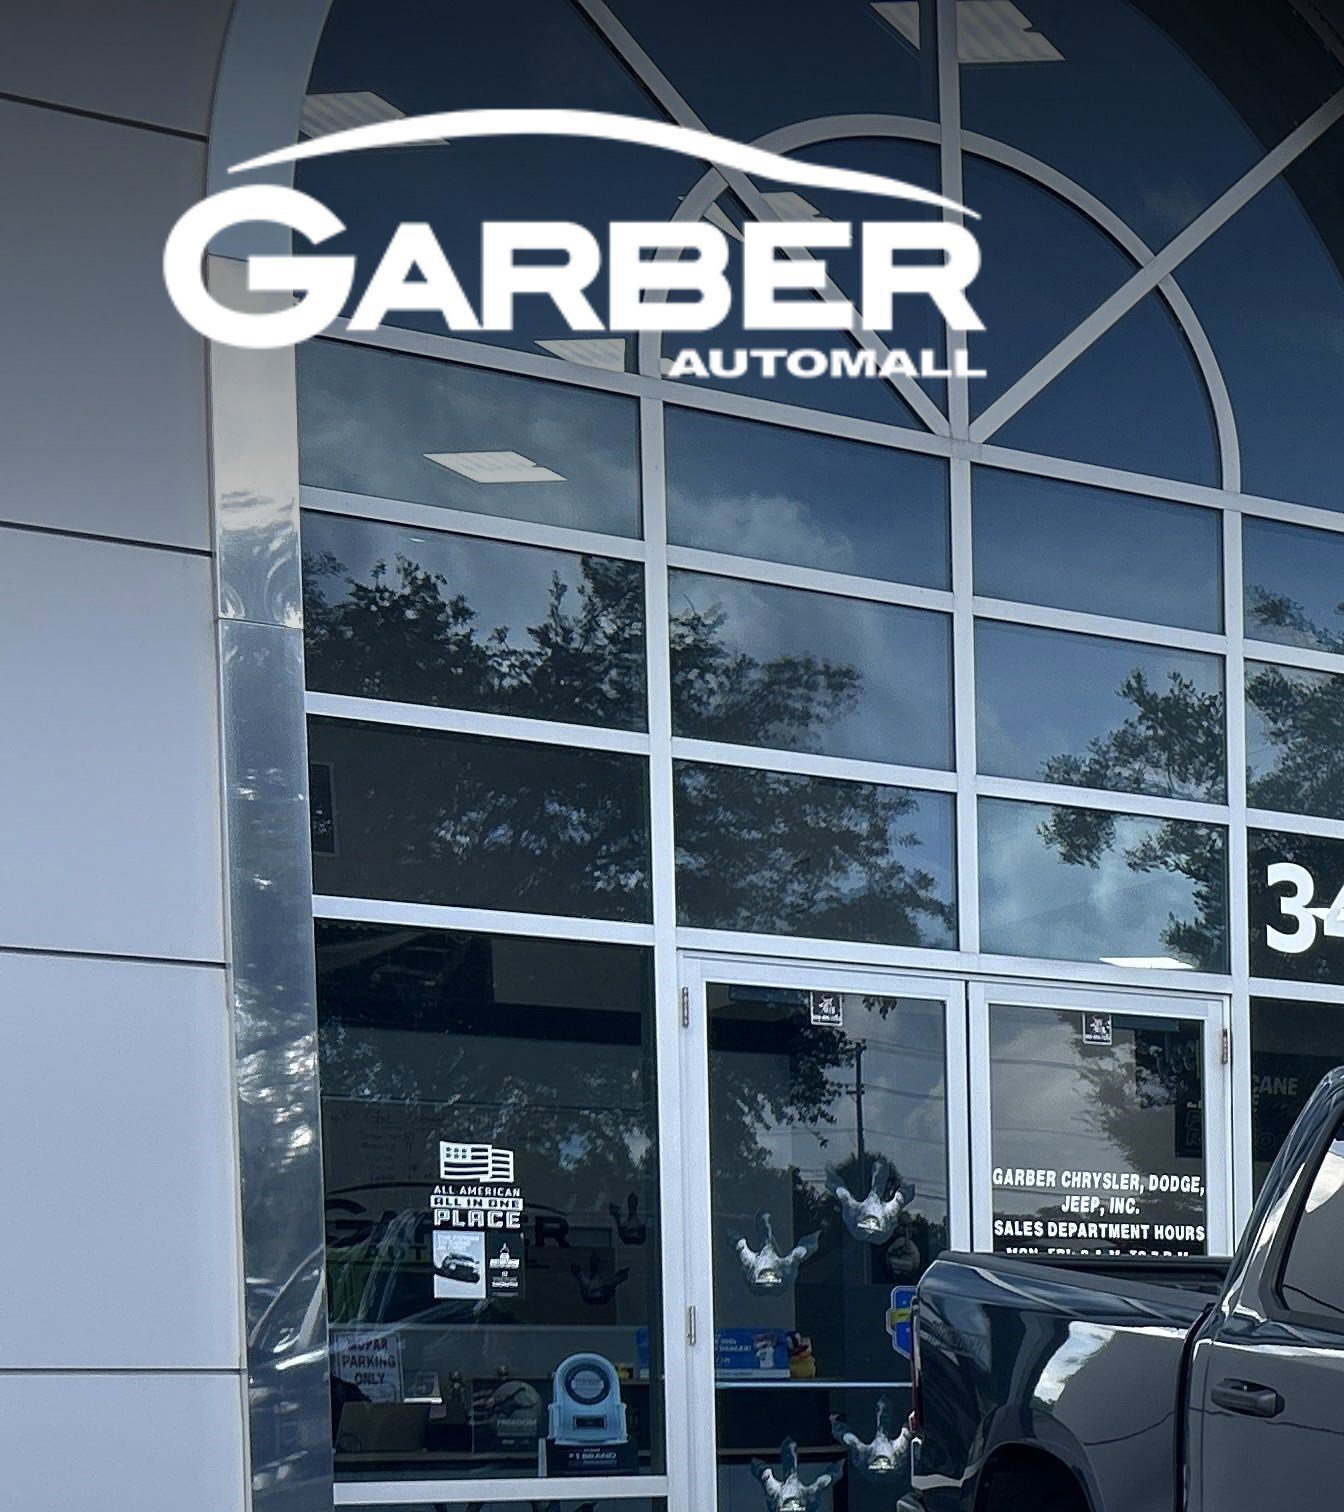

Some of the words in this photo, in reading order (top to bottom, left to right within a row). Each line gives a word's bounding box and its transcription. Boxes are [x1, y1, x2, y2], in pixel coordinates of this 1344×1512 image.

[433, 1185, 455, 1195] ALL
[459, 1186, 521, 1198] AMERICAN
[992, 1168, 1057, 1187] GARBER
[1061, 1170, 1145, 1194] CHRYSLER,
[1149, 1174, 1205, 1197] DODGE,
[434, 1198, 462, 1206] ALL
[1061, 1195, 1105, 1216] JEEP,
[1109, 1197, 1140, 1214] INC.
[433, 1208, 521, 1229] PLACE
[994, 1220, 1044, 1237] SALES
[1047, 1221, 1150, 1240] DEPARTMENT
[1154, 1224, 1206, 1241] HOURS
[341, 1354, 396, 1369] PARKING
[354, 1371, 385, 1385] ONLY
